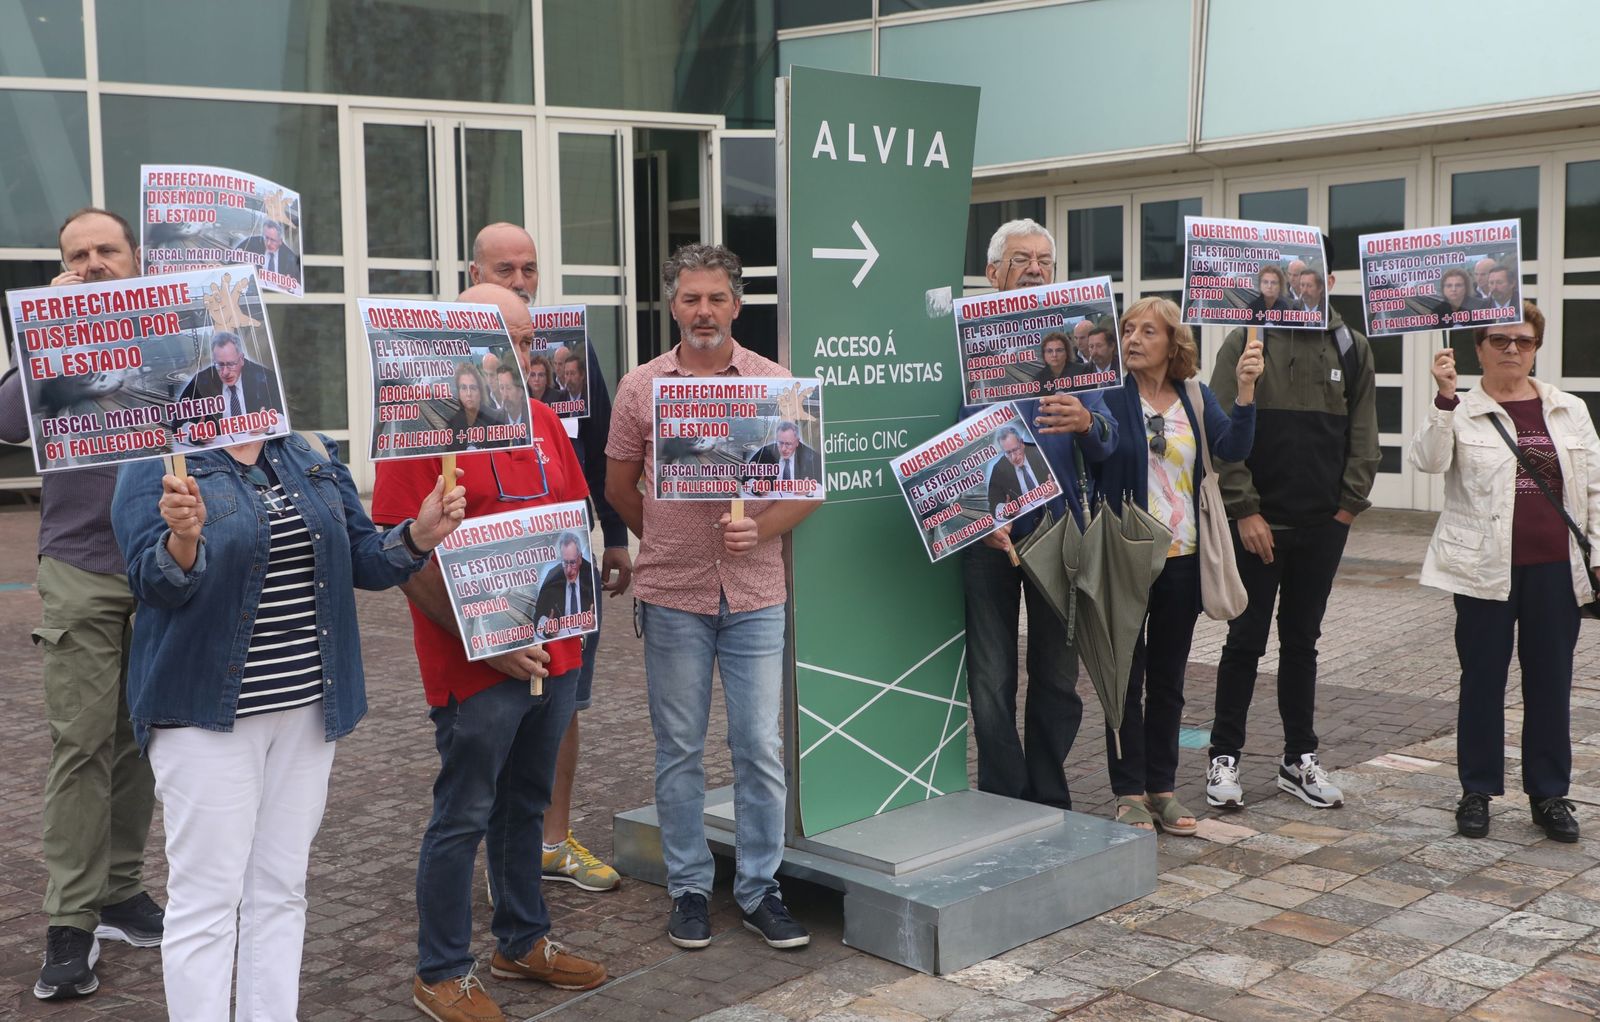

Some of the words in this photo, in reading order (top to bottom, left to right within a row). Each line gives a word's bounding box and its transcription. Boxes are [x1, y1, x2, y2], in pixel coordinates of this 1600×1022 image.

[812, 120, 950, 169] ALVIA
[148, 172, 256, 194] PERFECTAMENTE
[147, 189, 214, 205] DISEÑADO
[219, 193, 245, 207] POR
[147, 210, 162, 223] EL
[166, 209, 216, 223] ESTADO
[1192, 224, 1259, 240] QUEREMOS
[1263, 228, 1316, 244] JUSTICIA
[1367, 233, 1442, 255] QUEREMOS
[1447, 225, 1511, 245] JUSTICIA
[149, 250, 183, 260] FISCAL
[186, 250, 221, 260] MARIO
[226, 249, 265, 266] PIÑEIRO
[1192, 245, 1202, 257] EL
[1206, 247, 1241, 259] ESTADO
[1244, 249, 1280, 260] CONTRA
[1368, 262, 1378, 273] EL
[1382, 256, 1420, 271] ESTADO
[1424, 252, 1466, 265] CONTRA
[1192, 260, 1209, 271] LAS
[260, 269, 297, 289] HERIDOS
[1238, 277, 1254, 288] DEL
[1368, 273, 1387, 286] LAS
[1190, 289, 1223, 300] ESTADO
[1419, 285, 1436, 294] DEL
[22, 282, 191, 323] PERFECTAMENTE
[962, 294, 1039, 320] QUEREMOS
[1042, 284, 1105, 307] JUSTICIA
[1370, 300, 1405, 313] ESTADO
[368, 307, 443, 330] QUEREMOS
[446, 310, 500, 330] JUSTICIA
[532, 312, 580, 329] JUSTICIA
[1188, 308, 1198, 318] 81
[1200, 309, 1252, 320] FALLECIDOS
[1283, 310, 1322, 322] HERIDOS
[1371, 320, 1382, 330] 81
[1385, 314, 1439, 329] FALLECIDOS
[1472, 306, 1515, 320] HERIDOS
[25, 317, 134, 352] DISEÑADO
[141, 313, 181, 338] POR
[964, 328, 977, 339] EL
[980, 319, 1019, 337] ESTADO
[1022, 315, 1064, 330] CONTRA
[376, 339, 390, 358] EL
[393, 340, 430, 357] ESTADO
[431, 339, 471, 356] CONTRA
[814, 336, 881, 357] ACCESO
[885, 329, 896, 356] Á
[966, 341, 987, 354] LAS
[30, 357, 57, 380] EL
[63, 346, 142, 377] ESTADO
[1019, 351, 1037, 362] DEL
[379, 361, 399, 379] LAS
[815, 365, 860, 386] SALA
[864, 365, 885, 384] DE
[889, 362, 943, 383] VISTAS
[969, 368, 1005, 382] ESTADO
[434, 383, 452, 398] DEL
[660, 384, 768, 399] PERFECTAMENTE
[970, 389, 982, 400] 81
[984, 381, 1040, 398] FALLECIDOS
[1074, 370, 1116, 386] HERIDOS
[42, 413, 101, 437] FISCAL
[106, 406, 162, 431] MARIO
[167, 395, 226, 422] PIÑEIRO
[380, 404, 419, 422] ESTADO
[660, 401, 726, 418] DISEÑADO
[731, 404, 757, 418] POR
[46, 443, 65, 461] 81
[70, 429, 166, 459] FALLECIDOS
[219, 409, 279, 437] HERIDOS
[378, 434, 390, 450] 81
[393, 430, 453, 448] FALLECIDOS
[488, 423, 526, 441] HERIDOS
[660, 423, 675, 438] EL
[680, 423, 729, 437] ESTADO
[824, 433, 867, 454] dificio
[872, 430, 907, 449] CINC
[899, 434, 964, 477] QUEREMOS
[965, 405, 1015, 438] JUSTICIA
[662, 465, 697, 477] FISCAL
[701, 465, 735, 476] MARIO
[739, 462, 780, 476] PIÑEIRO
[910, 486, 924, 500] EL
[924, 466, 960, 492] ESTADO
[961, 445, 997, 471] CONTRA
[662, 481, 673, 493] 81
[676, 481, 737, 492] FALLECIDOS
[773, 480, 817, 492] HERIDOS
[825, 470, 872, 492] NDAR
[875, 468, 883, 486] 1
[916, 497, 937, 514] LAS
[932, 541, 945, 553] 81
[944, 516, 994, 546] FALLECIDOS
[1018, 481, 1054, 506] HERIDOS
[443, 519, 523, 550] QUEREMOS
[528, 509, 583, 533] JUSTICIA
[450, 563, 466, 578] EL
[469, 554, 512, 577] ESTADO
[516, 546, 556, 566] CONTRA
[456, 580, 480, 598] LAS
[471, 636, 484, 649] 81
[487, 625, 534, 647] FALLECIDOS
[559, 611, 592, 630] HERIDOS
